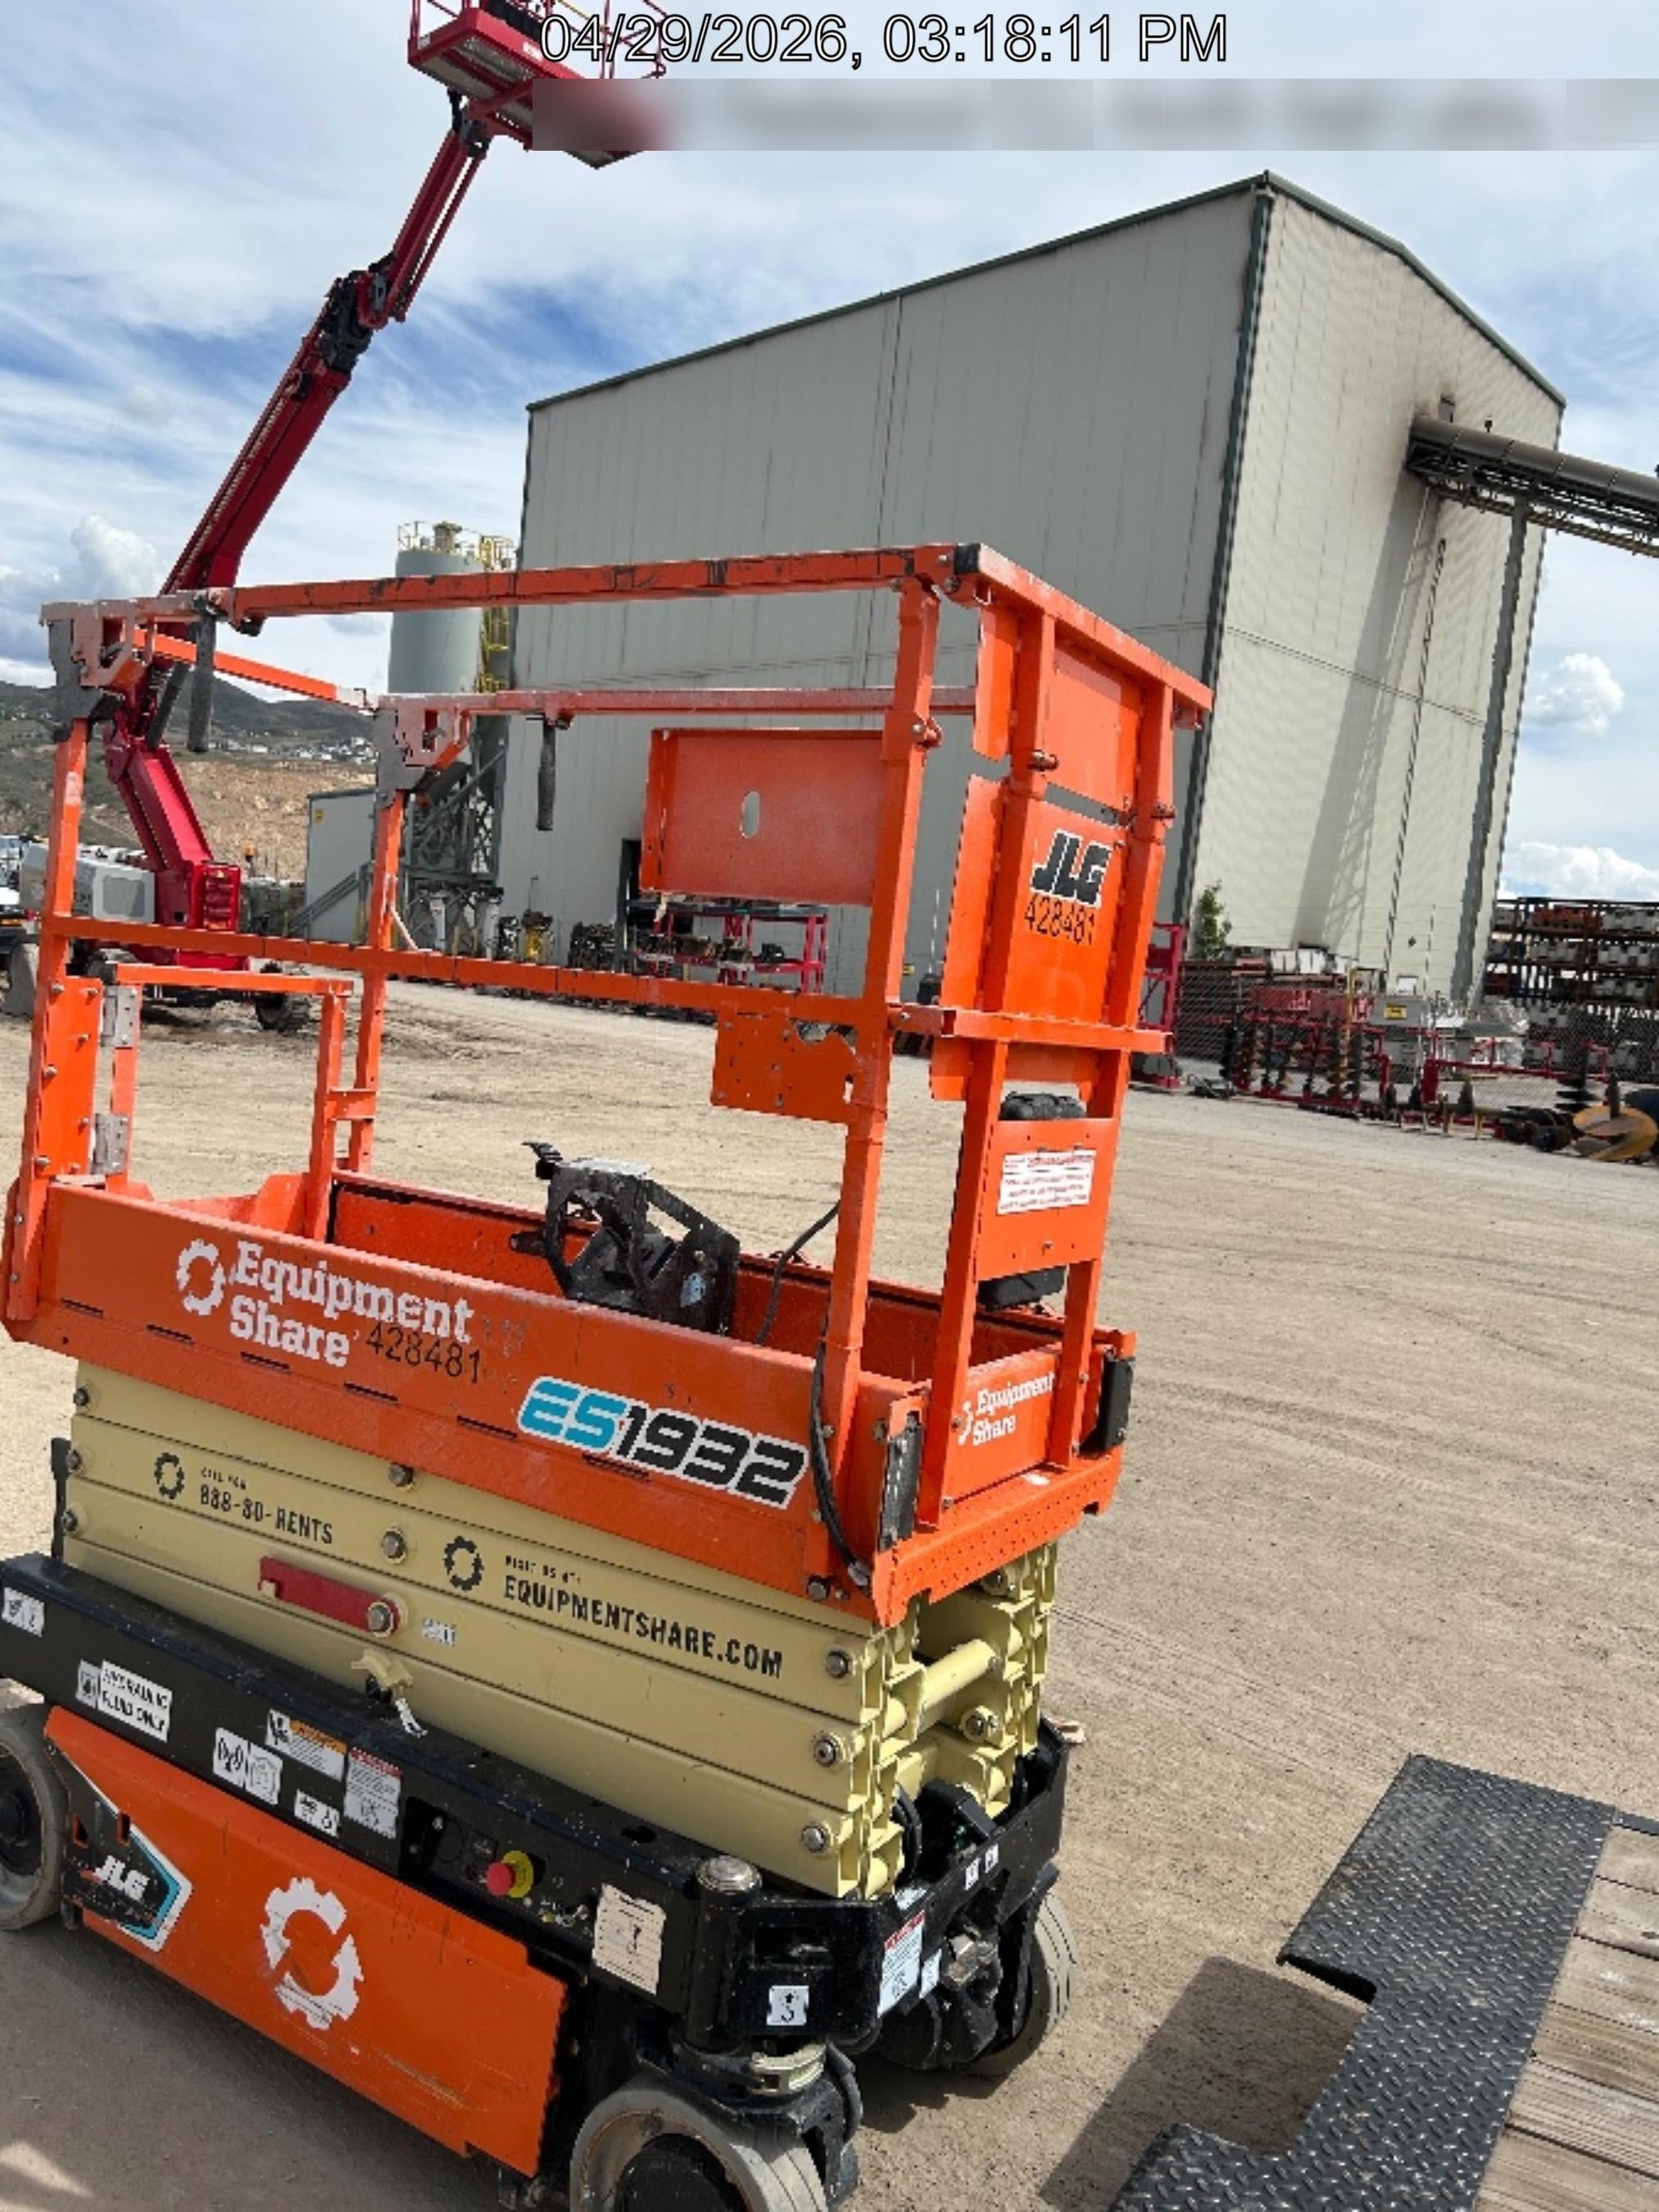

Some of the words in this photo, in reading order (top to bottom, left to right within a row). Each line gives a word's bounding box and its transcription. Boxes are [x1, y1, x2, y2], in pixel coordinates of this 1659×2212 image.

[1030, 828, 1112, 909] JLG
[1025, 893, 1095, 944] 428481
[234, 1240, 474, 1343] Equipment
[230, 1294, 350, 1367] Share
[366, 1322, 481, 1384] 428481
[976, 1371, 1055, 1416] Equipment
[519, 1376, 809, 1509] ES1932
[972, 1415, 1016, 1445] Share
[504, 1575, 782, 1679] EQUIPMENTSHARE.COM
[93, 1855, 150, 1901] JLG
